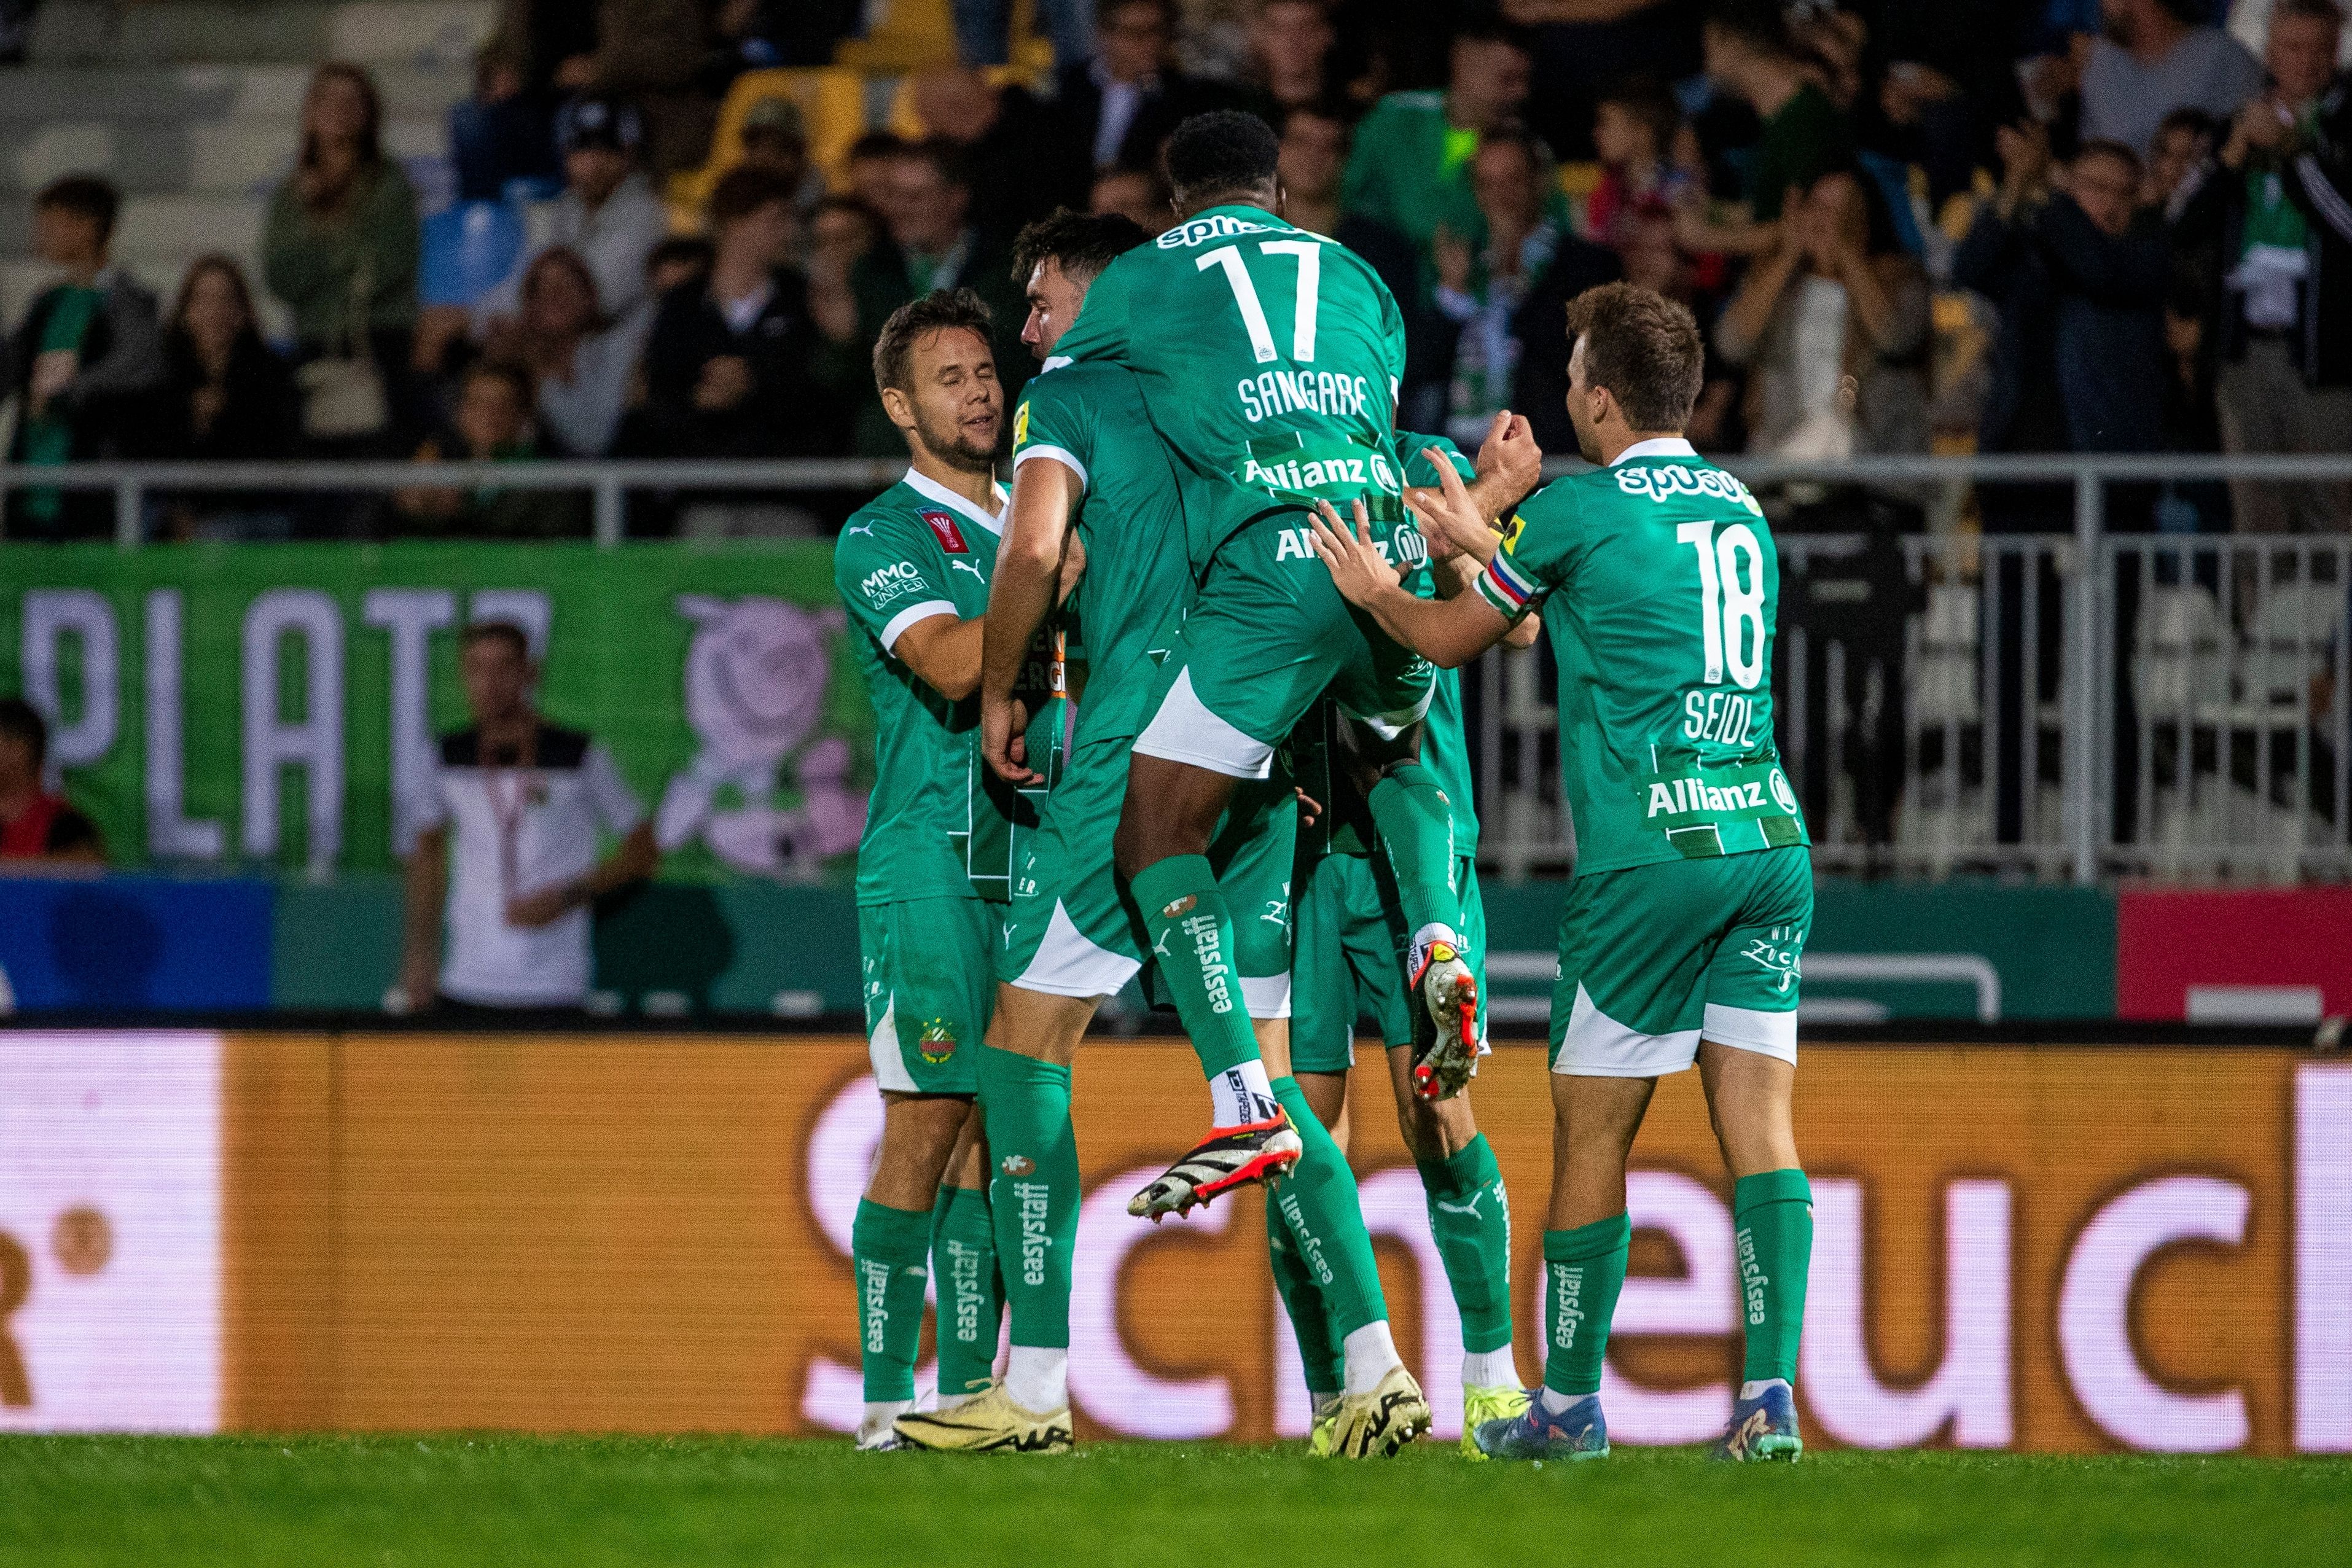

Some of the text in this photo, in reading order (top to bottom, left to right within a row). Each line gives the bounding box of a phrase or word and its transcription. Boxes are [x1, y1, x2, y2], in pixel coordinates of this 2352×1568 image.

[1195, 241, 1321, 364] 17
[1244, 453, 1367, 490] Allianz
[861, 561, 918, 598] MMO
[1677, 520, 1766, 690] 18
[1684, 690, 1755, 748] SEIDL
[1647, 777, 1768, 819] Allianz
[1181, 913, 1233, 1015] easystaff
[1014, 1182, 1053, 1286] easystaff
[861, 1257, 890, 1353] easystaff
[947, 1239, 984, 1342] easystaff
[1553, 1263, 1584, 1349] easystaff
